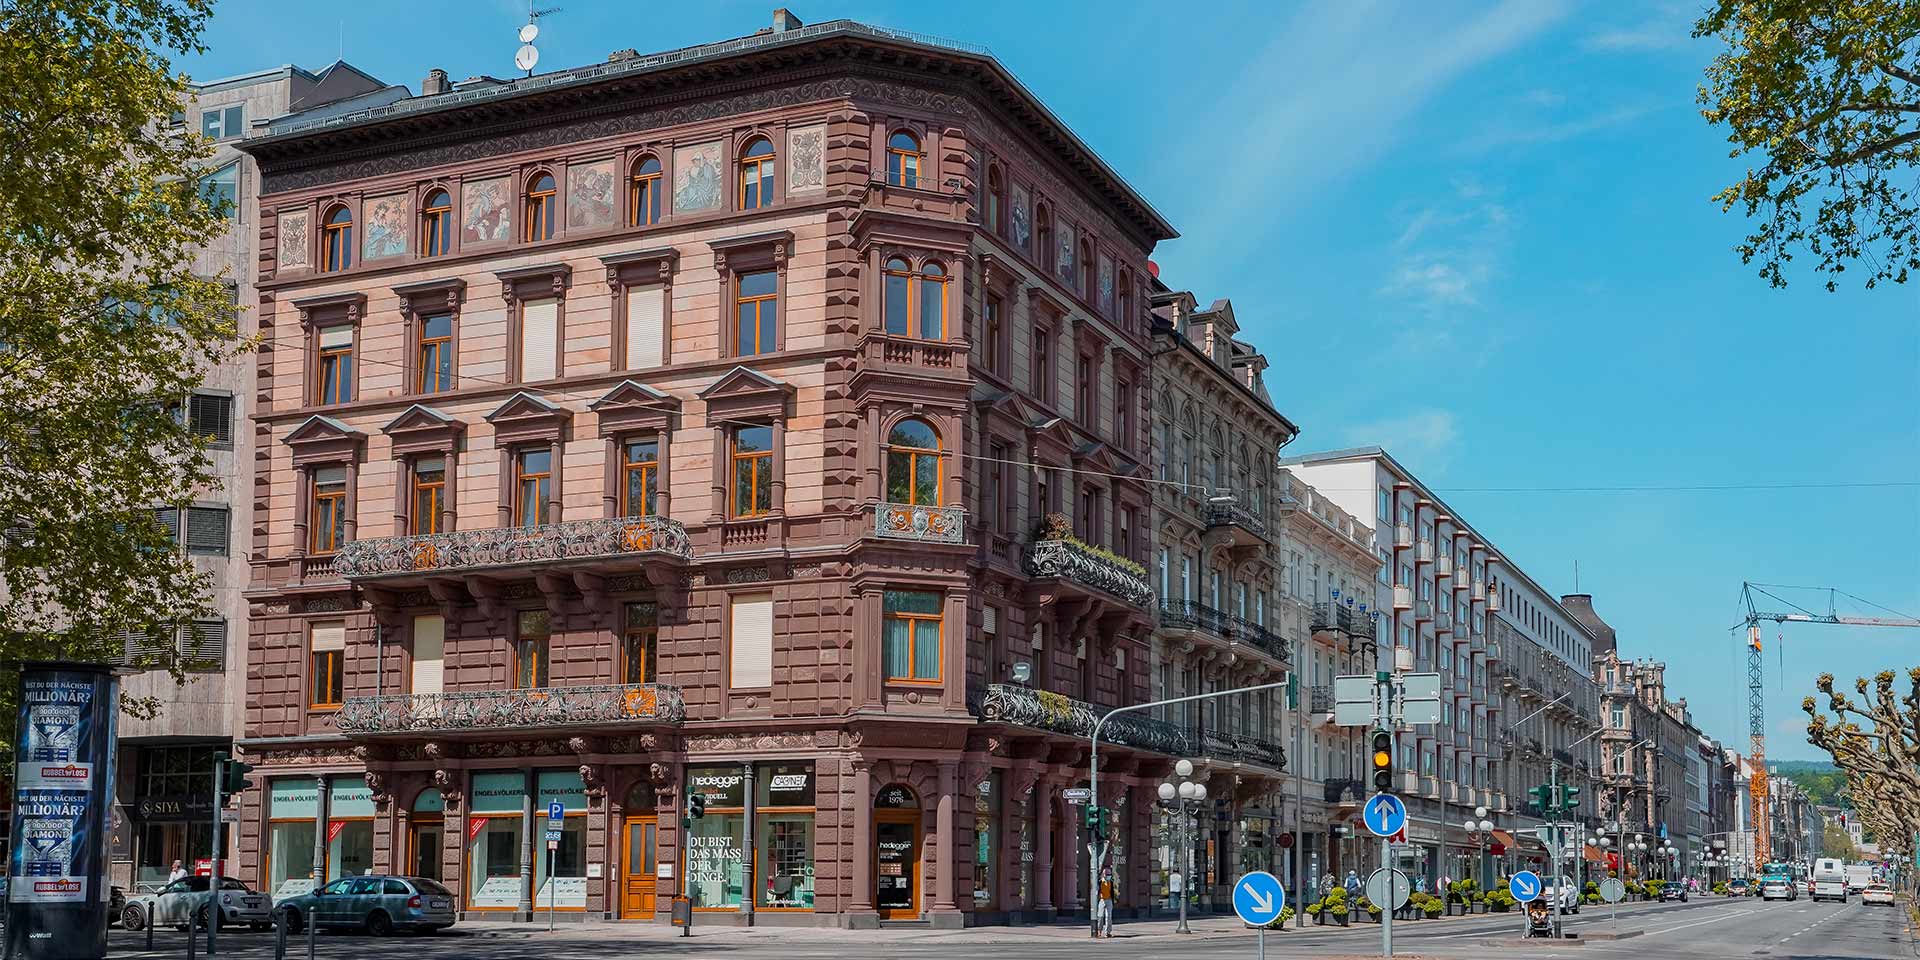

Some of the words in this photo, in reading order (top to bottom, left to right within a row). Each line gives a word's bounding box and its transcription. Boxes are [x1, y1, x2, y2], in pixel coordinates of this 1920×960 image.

[46, 681, 59, 689] DER
[61, 681, 91, 689] NÄCHSTE
[25, 690, 91, 703] MILLIONÄR?
[32, 716, 76, 725] DIAMOND
[774, 776, 804, 786] CABINET
[54, 794, 85, 802] NÄCHSTE
[18, 803, 85, 816] MILLIONÄR?
[155, 801, 181, 813] SIYA
[551, 804, 561, 818] P
[25, 830, 71, 839] DIAMOND
[690, 836, 706, 847] DU
[708, 836, 733, 847] BIST
[690, 848, 711, 859] DAS
[712, 848, 742, 859] MASS
[690, 860, 712, 871] DER
[690, 872, 727, 883] DINGE.
